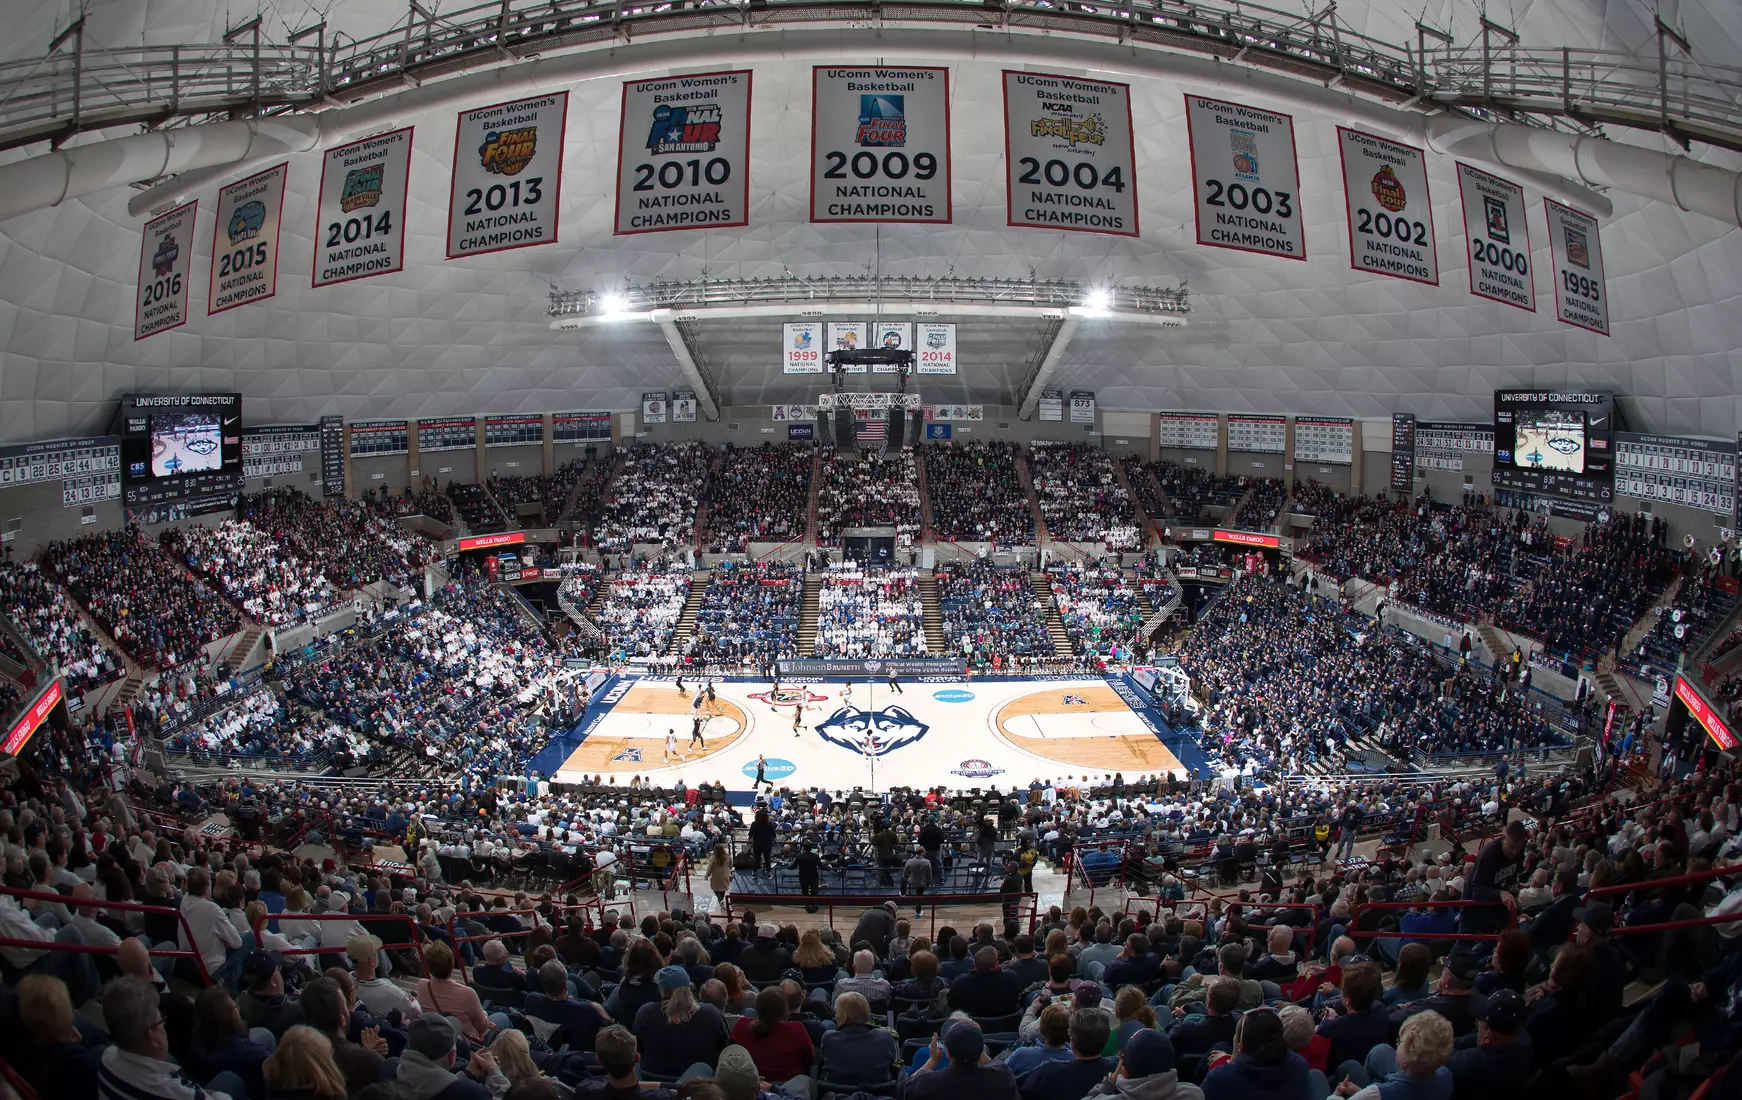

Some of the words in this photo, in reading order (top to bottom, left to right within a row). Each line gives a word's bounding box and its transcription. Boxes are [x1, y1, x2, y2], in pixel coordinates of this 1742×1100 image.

[636, 82, 677, 93] UConn
[681, 76, 738, 88] Women's
[828, 70, 871, 79] UConn
[875, 70, 934, 80] Women's
[847, 82, 915, 92] Basketball
[1017, 76, 1058, 88] UConn
[1062, 80, 1117, 95] Women's
[653, 89, 718, 104] Basketball
[1036, 90, 1100, 105] Basketball
[469, 108, 502, 122] UConn
[506, 97, 555, 113] Women's
[1042, 102, 1073, 113] NCAA
[1197, 99, 1233, 115] UConn
[1236, 107, 1282, 125] Women's
[483, 112, 537, 131] Basketball
[1215, 115, 1269, 134] Basketball
[333, 146, 360, 159] UConn
[363, 134, 403, 151] Women's
[659, 143, 675, 153] SAN
[675, 142, 709, 151] ANTONIO
[1347, 132, 1377, 149] UConn
[1379, 140, 1417, 159] Women's
[343, 149, 388, 168] Basketball
[824, 151, 937, 180] 2009
[1362, 148, 1406, 167] Basketball
[226, 183, 247, 196] UConn
[249, 169, 280, 186] Women's
[633, 157, 731, 192] 2010
[1018, 157, 1126, 194] 2004
[1464, 168, 1487, 182] UConn
[1488, 176, 1517, 194] Women's
[234, 184, 268, 203] Basketball
[464, 177, 543, 216] 2013
[638, 192, 724, 209] NATIONAL
[836, 186, 926, 198] NATIONAL
[1031, 191, 1116, 210] NATIONAL
[1205, 179, 1292, 219] 2003
[1476, 183, 1510, 201] Basketball
[631, 209, 731, 227] CHAMPIONS
[828, 203, 934, 216] CHAMPIONS
[1025, 209, 1123, 229] CHAMPIONS
[155, 220, 182, 238] Basketball
[326, 210, 392, 249] 2014
[466, 211, 537, 233] NATIONAL
[1216, 212, 1286, 235] NATIONAL
[1357, 208, 1428, 247] 2002
[1560, 217, 1587, 233] Basketball
[459, 227, 543, 250] CHAMPIONS
[1211, 229, 1293, 252] CHAMPIONS
[219, 241, 267, 278] 2015
[328, 242, 386, 264] NATIONAL
[1366, 239, 1423, 262] NATIONAL
[1472, 238, 1528, 276] 2000
[323, 257, 391, 280] CHAMPIONS
[1363, 255, 1429, 278] CHAMPIONS
[220, 270, 263, 292] NATIONAL
[1481, 268, 1524, 289] NATIONAL
[1561, 269, 1600, 301] 1995
[143, 273, 181, 307] 2016
[216, 284, 266, 307] CHAMPIONS
[1478, 281, 1528, 305] CHAMPIONS
[144, 301, 178, 319] NATIONAL
[1565, 296, 1600, 316] NATIONAL
[141, 312, 180, 334] CHAMPIONS
[1564, 309, 1604, 329] CHAMPIONS
[788, 351, 818, 361] 1999
[922, 351, 951, 361] 2014
[136, 397, 180, 407] UNIVERSITY
[181, 397, 188, 406] OF
[191, 397, 235, 405] CONNECTICUT
[1074, 400, 1090, 408] 873
[1501, 393, 1537, 402] UNIVERSITY
[1538, 393, 1547, 402] OF
[1548, 393, 1599, 403] CONNECTICUT
[49, 463, 60, 475] 25
[64, 462, 75, 473] 42
[79, 460, 90, 471] 44
[108, 456, 119, 467] 42
[33, 466, 44, 477] 22
[237, 476, 245, 486] 25
[1723, 466, 1731, 477] 14
[82, 488, 90, 499] 13
[95, 486, 105, 496] 22
[1493, 472, 1500, 482] 55
[1601, 487, 1610, 498] 25
[65, 491, 77, 502] 24
[127, 491, 137, 502] 55
[1704, 494, 1715, 506] 24
[1721, 496, 1732, 509] 33
[1246, 535, 1264, 543] FARGO
[925, 661, 959, 669] Management
[600, 680, 634, 704] UCONN
